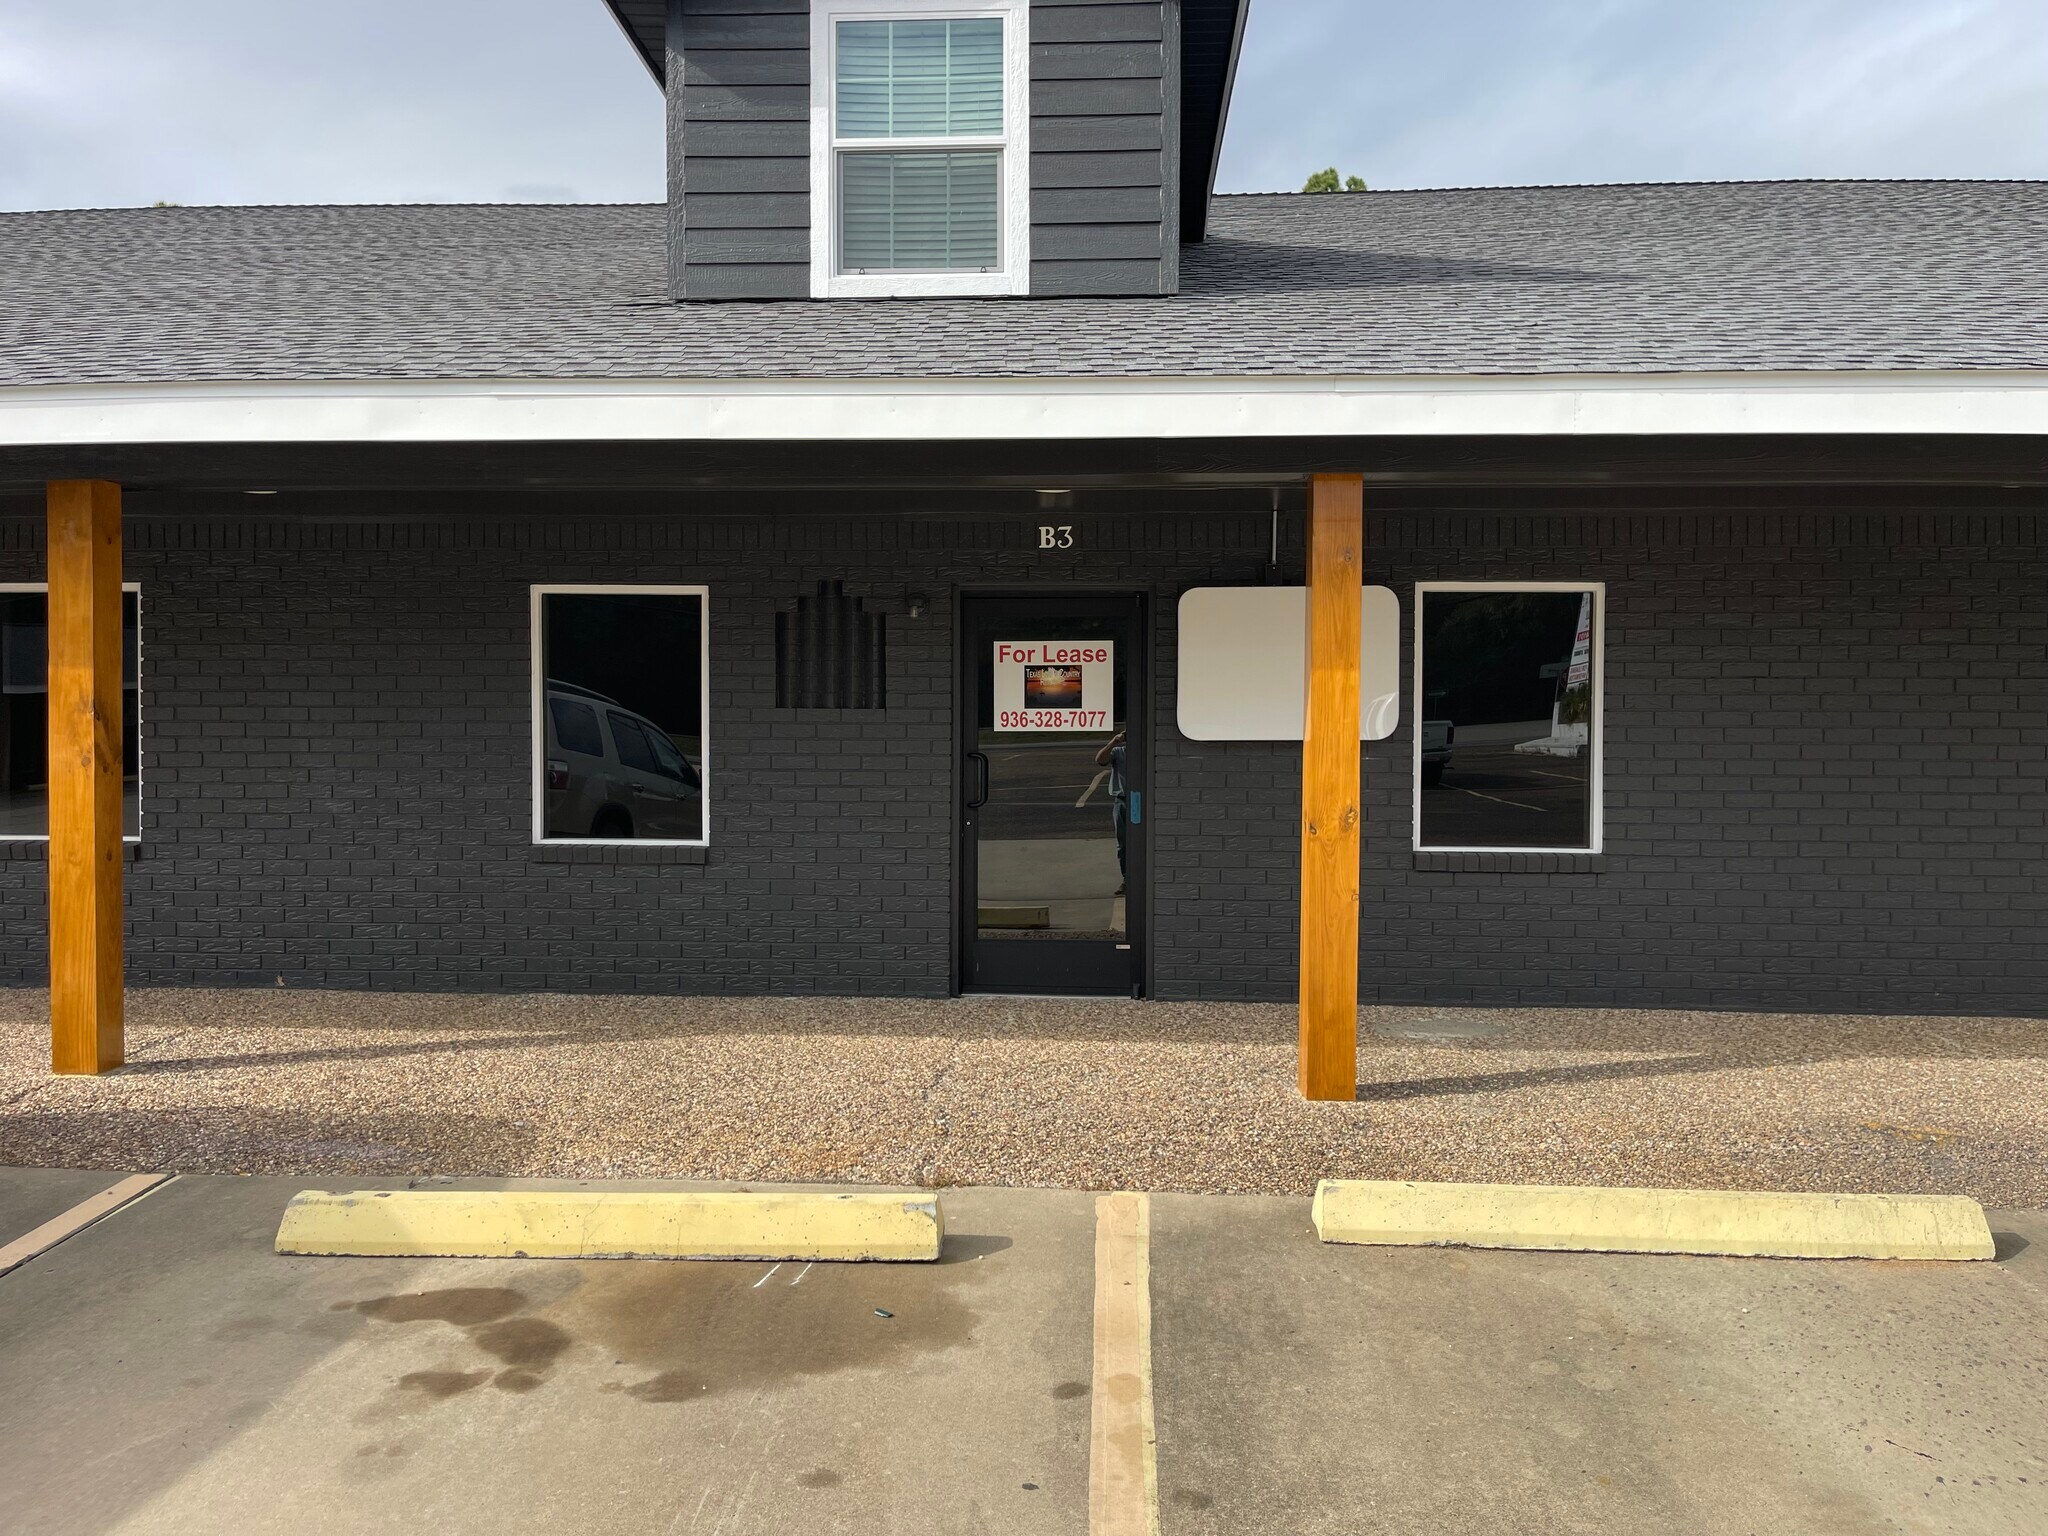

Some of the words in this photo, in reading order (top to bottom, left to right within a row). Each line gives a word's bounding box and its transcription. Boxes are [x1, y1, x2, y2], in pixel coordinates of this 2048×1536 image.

[1039, 526, 1073, 548] B3
[999, 645, 1035, 662] For
[1043, 645, 1107, 662] Lease
[1000, 711, 1106, 728] 936-328-7077
